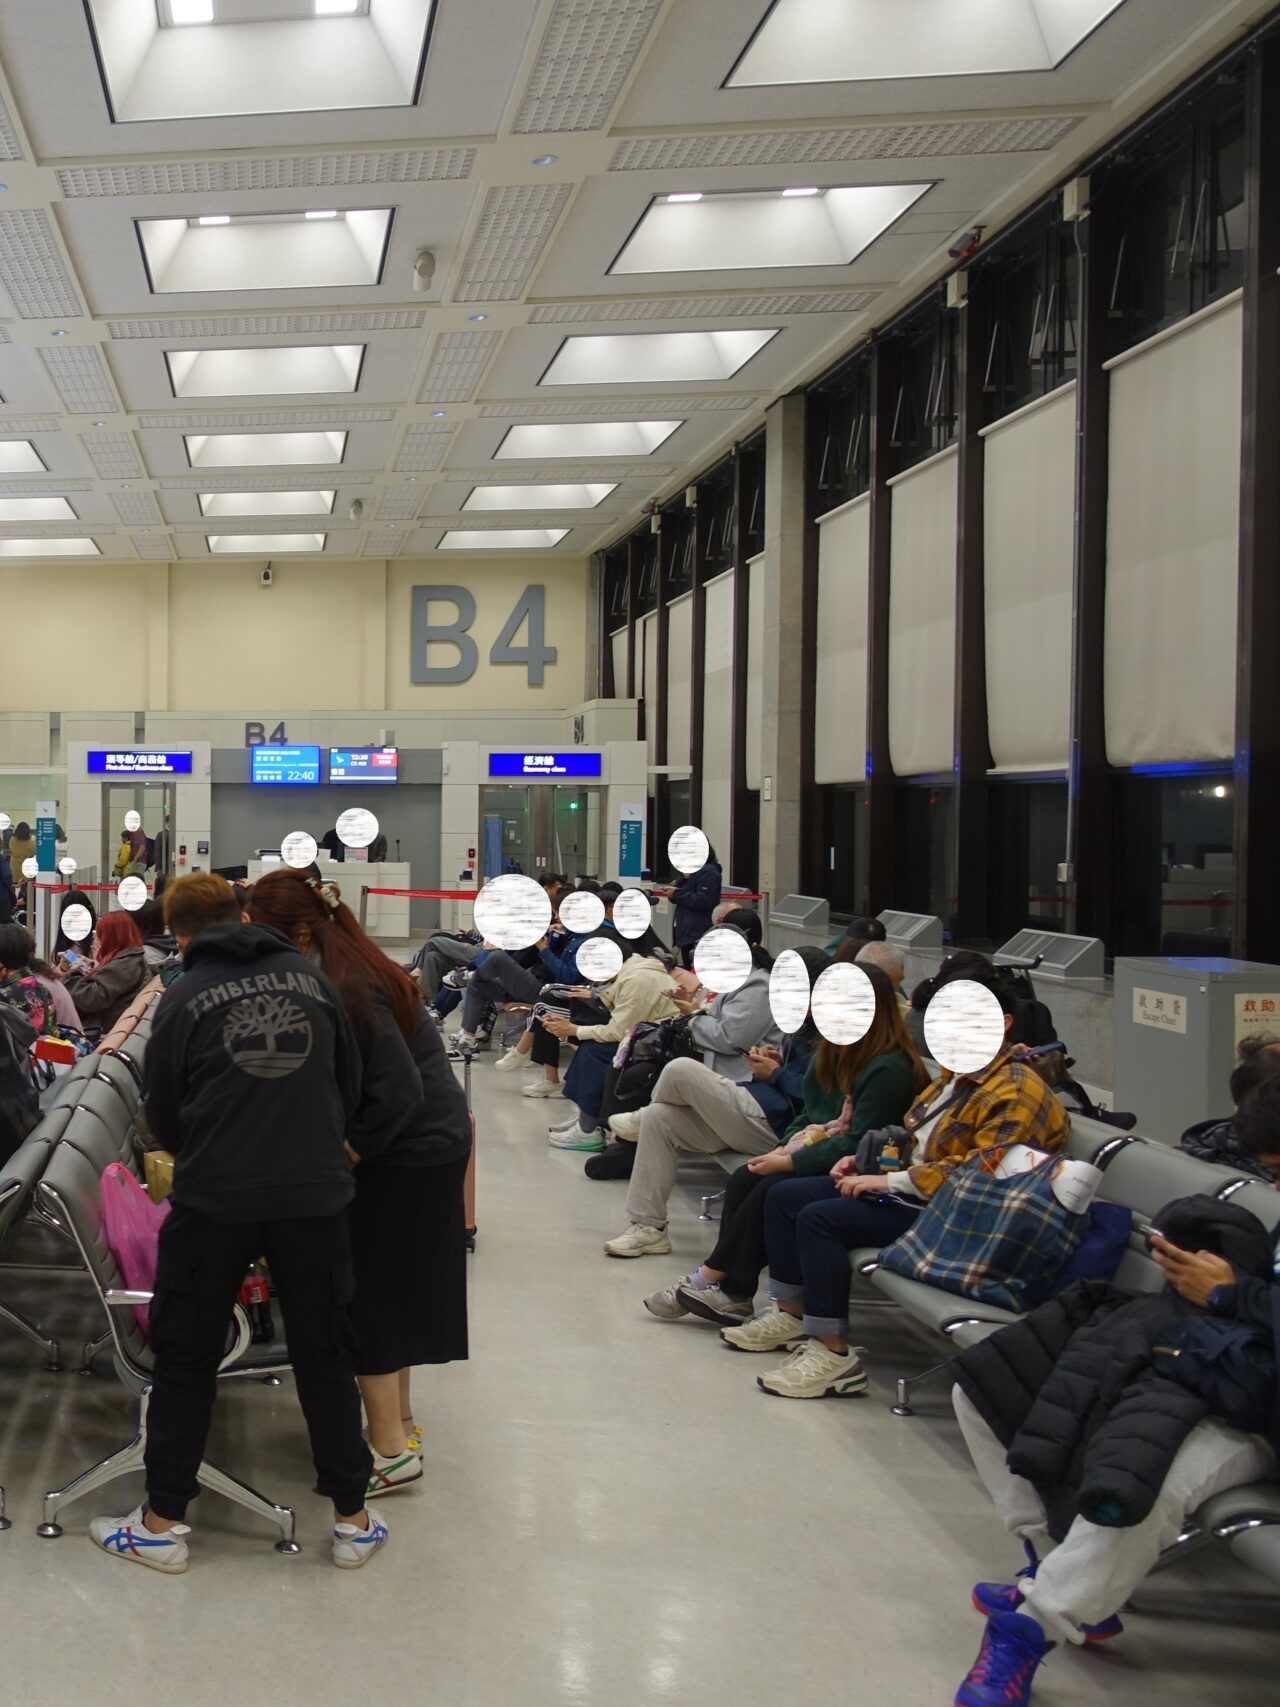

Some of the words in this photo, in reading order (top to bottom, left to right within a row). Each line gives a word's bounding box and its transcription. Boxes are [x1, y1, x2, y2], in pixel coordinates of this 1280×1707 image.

[410, 584, 558, 687] B4
[245, 721, 288, 748] B4
[287, 770, 315, 781] 22:40
[186, 972, 327, 1020] TIMBERLAND
